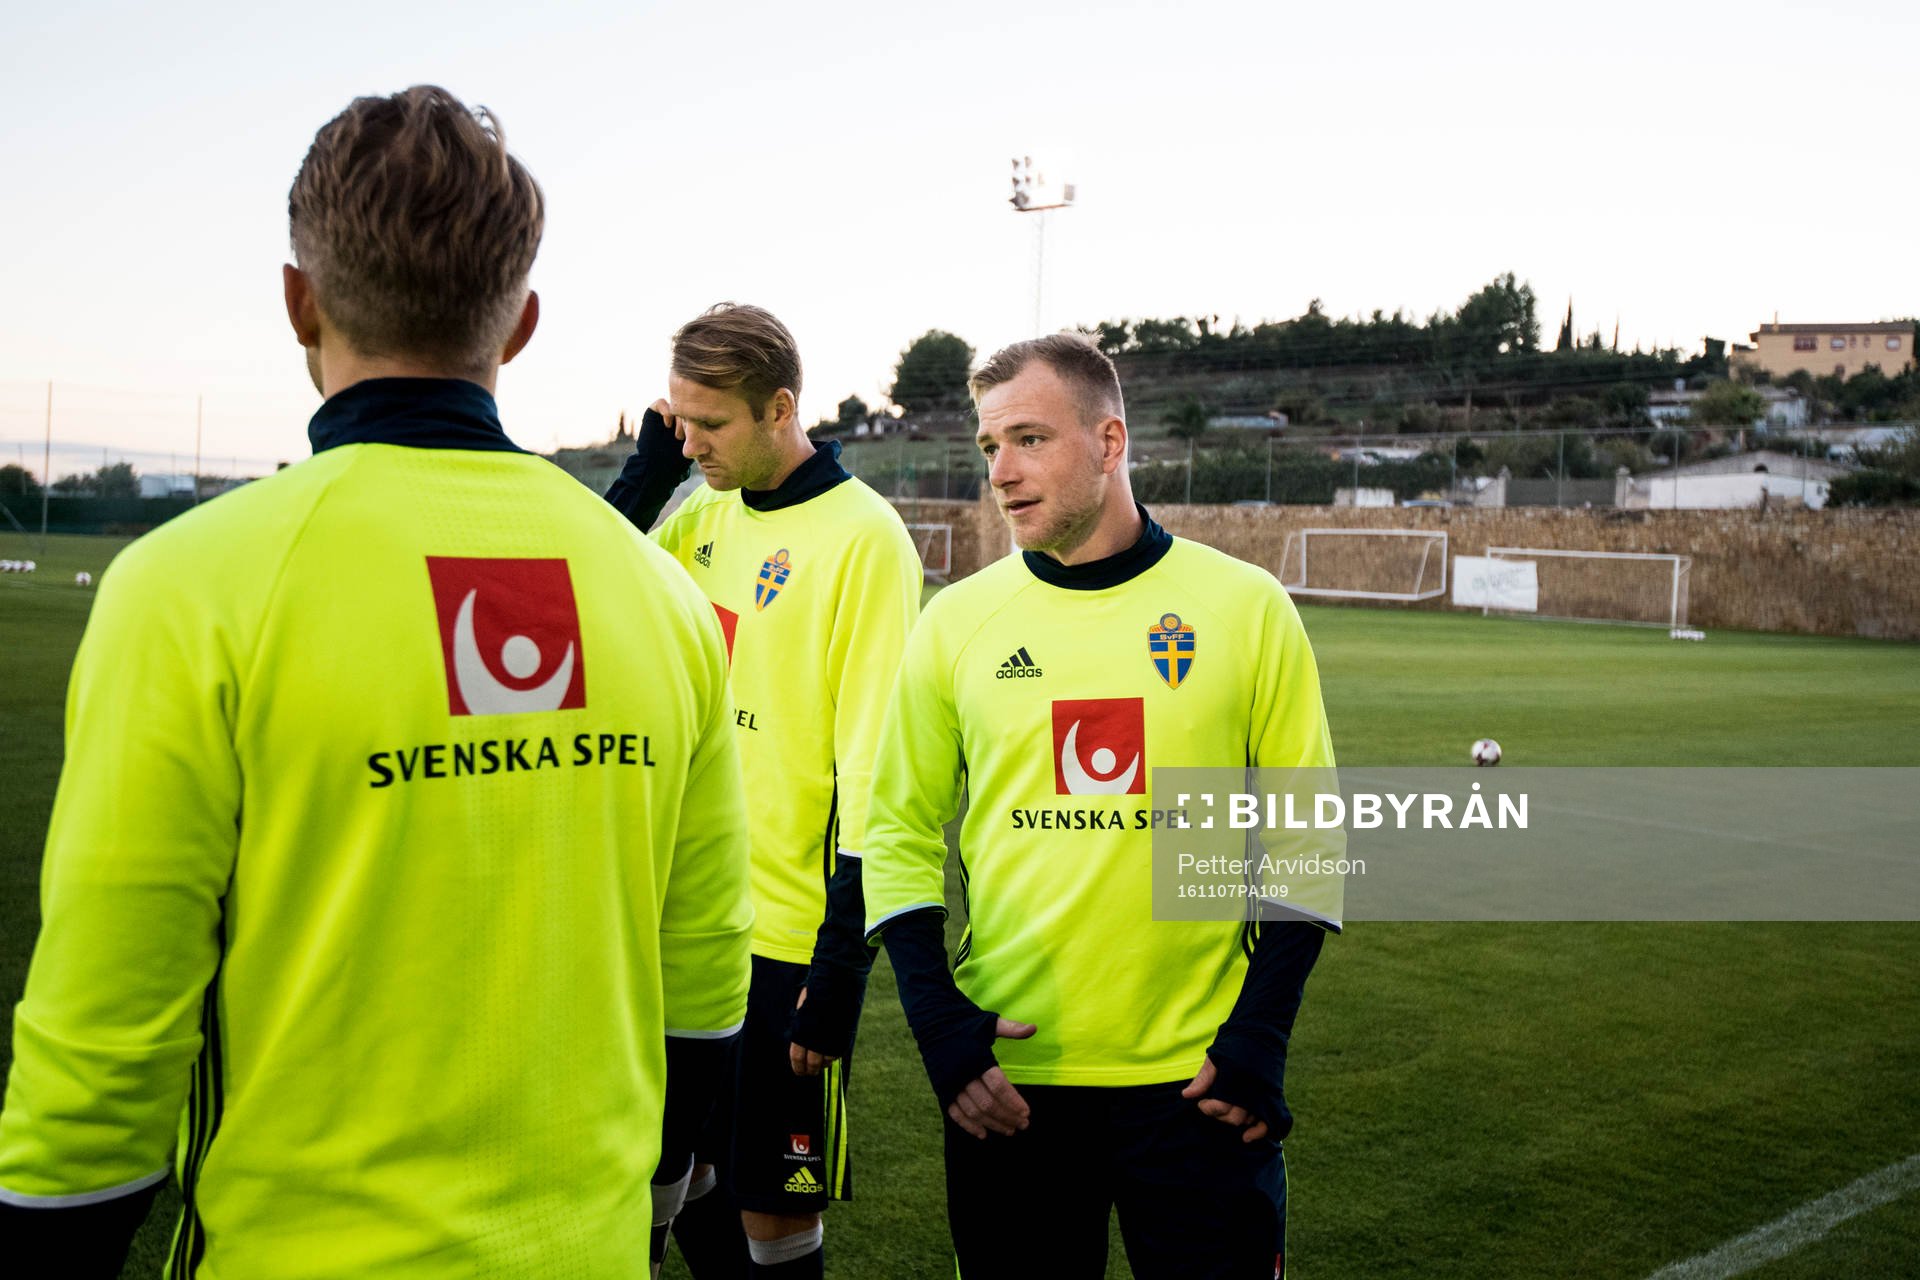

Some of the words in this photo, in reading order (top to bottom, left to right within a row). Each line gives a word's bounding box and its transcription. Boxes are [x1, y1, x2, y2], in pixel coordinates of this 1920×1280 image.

[995, 666, 1043, 679] adidas
[734, 708, 758, 731] EL
[367, 737, 560, 788] SVENSKA
[572, 733, 656, 767] SPEL
[1011, 809, 1125, 830] SVENSKA
[784, 1183, 823, 1193] adidas
